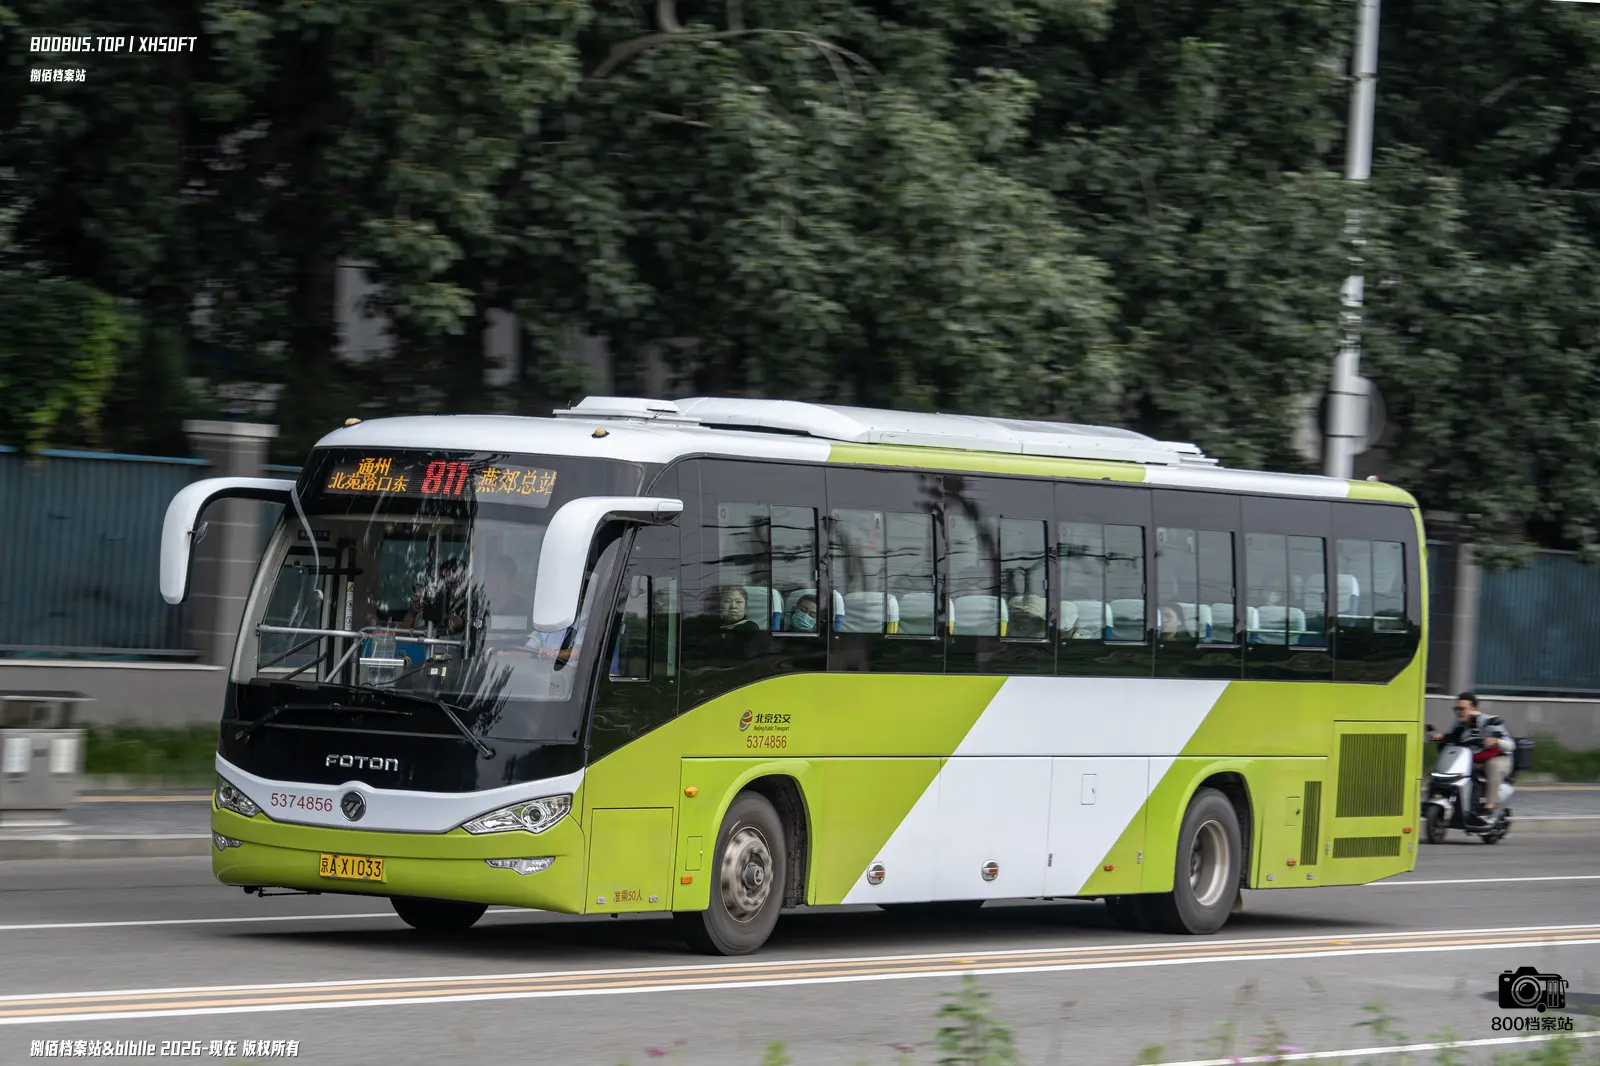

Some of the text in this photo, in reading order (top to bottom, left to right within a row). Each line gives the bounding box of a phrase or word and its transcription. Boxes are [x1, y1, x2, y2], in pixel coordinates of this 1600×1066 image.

[358, 458, 392, 476] 通州
[328, 472, 409, 493] 北苑路口东
[420, 460, 470, 495] 811
[476, 467, 558, 496] 燕郊总站
[755, 713, 791, 723] 北京公交
[746, 735, 787, 749] 5374856
[325, 754, 399, 772] FOTON
[270, 792, 333, 812] 5374856
[613, 889, 643, 903] 准乘50人
